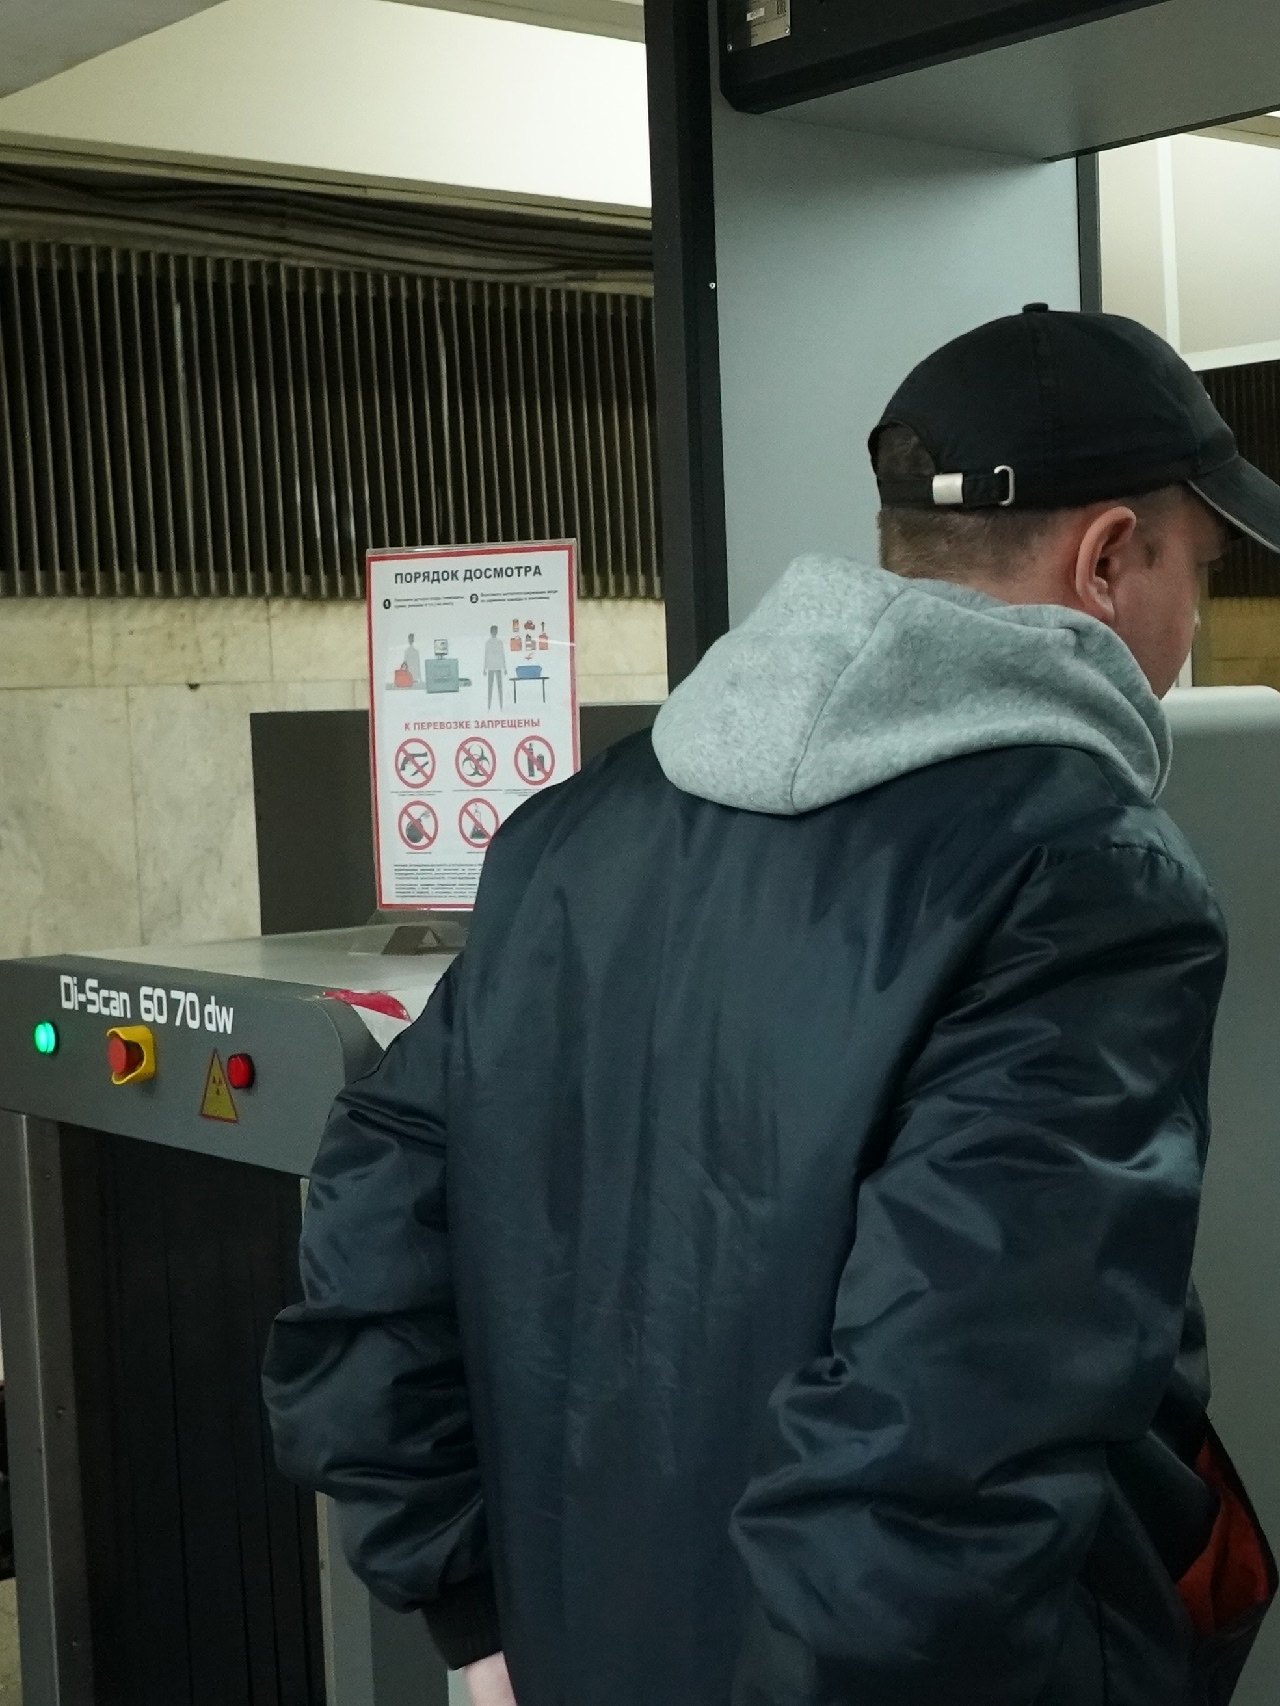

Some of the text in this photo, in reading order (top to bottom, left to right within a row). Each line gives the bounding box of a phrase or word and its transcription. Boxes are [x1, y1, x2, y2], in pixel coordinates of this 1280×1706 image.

[394, 565, 542, 585] ПОРЯДОК ДОСМОТРА
[404, 718, 540, 732] К ПЕРЕВОЗКЕ ЗАПРЕЩЕНЫ
[60, 974, 131, 1019] Di-Scan
[204, 995, 234, 1035] dw
